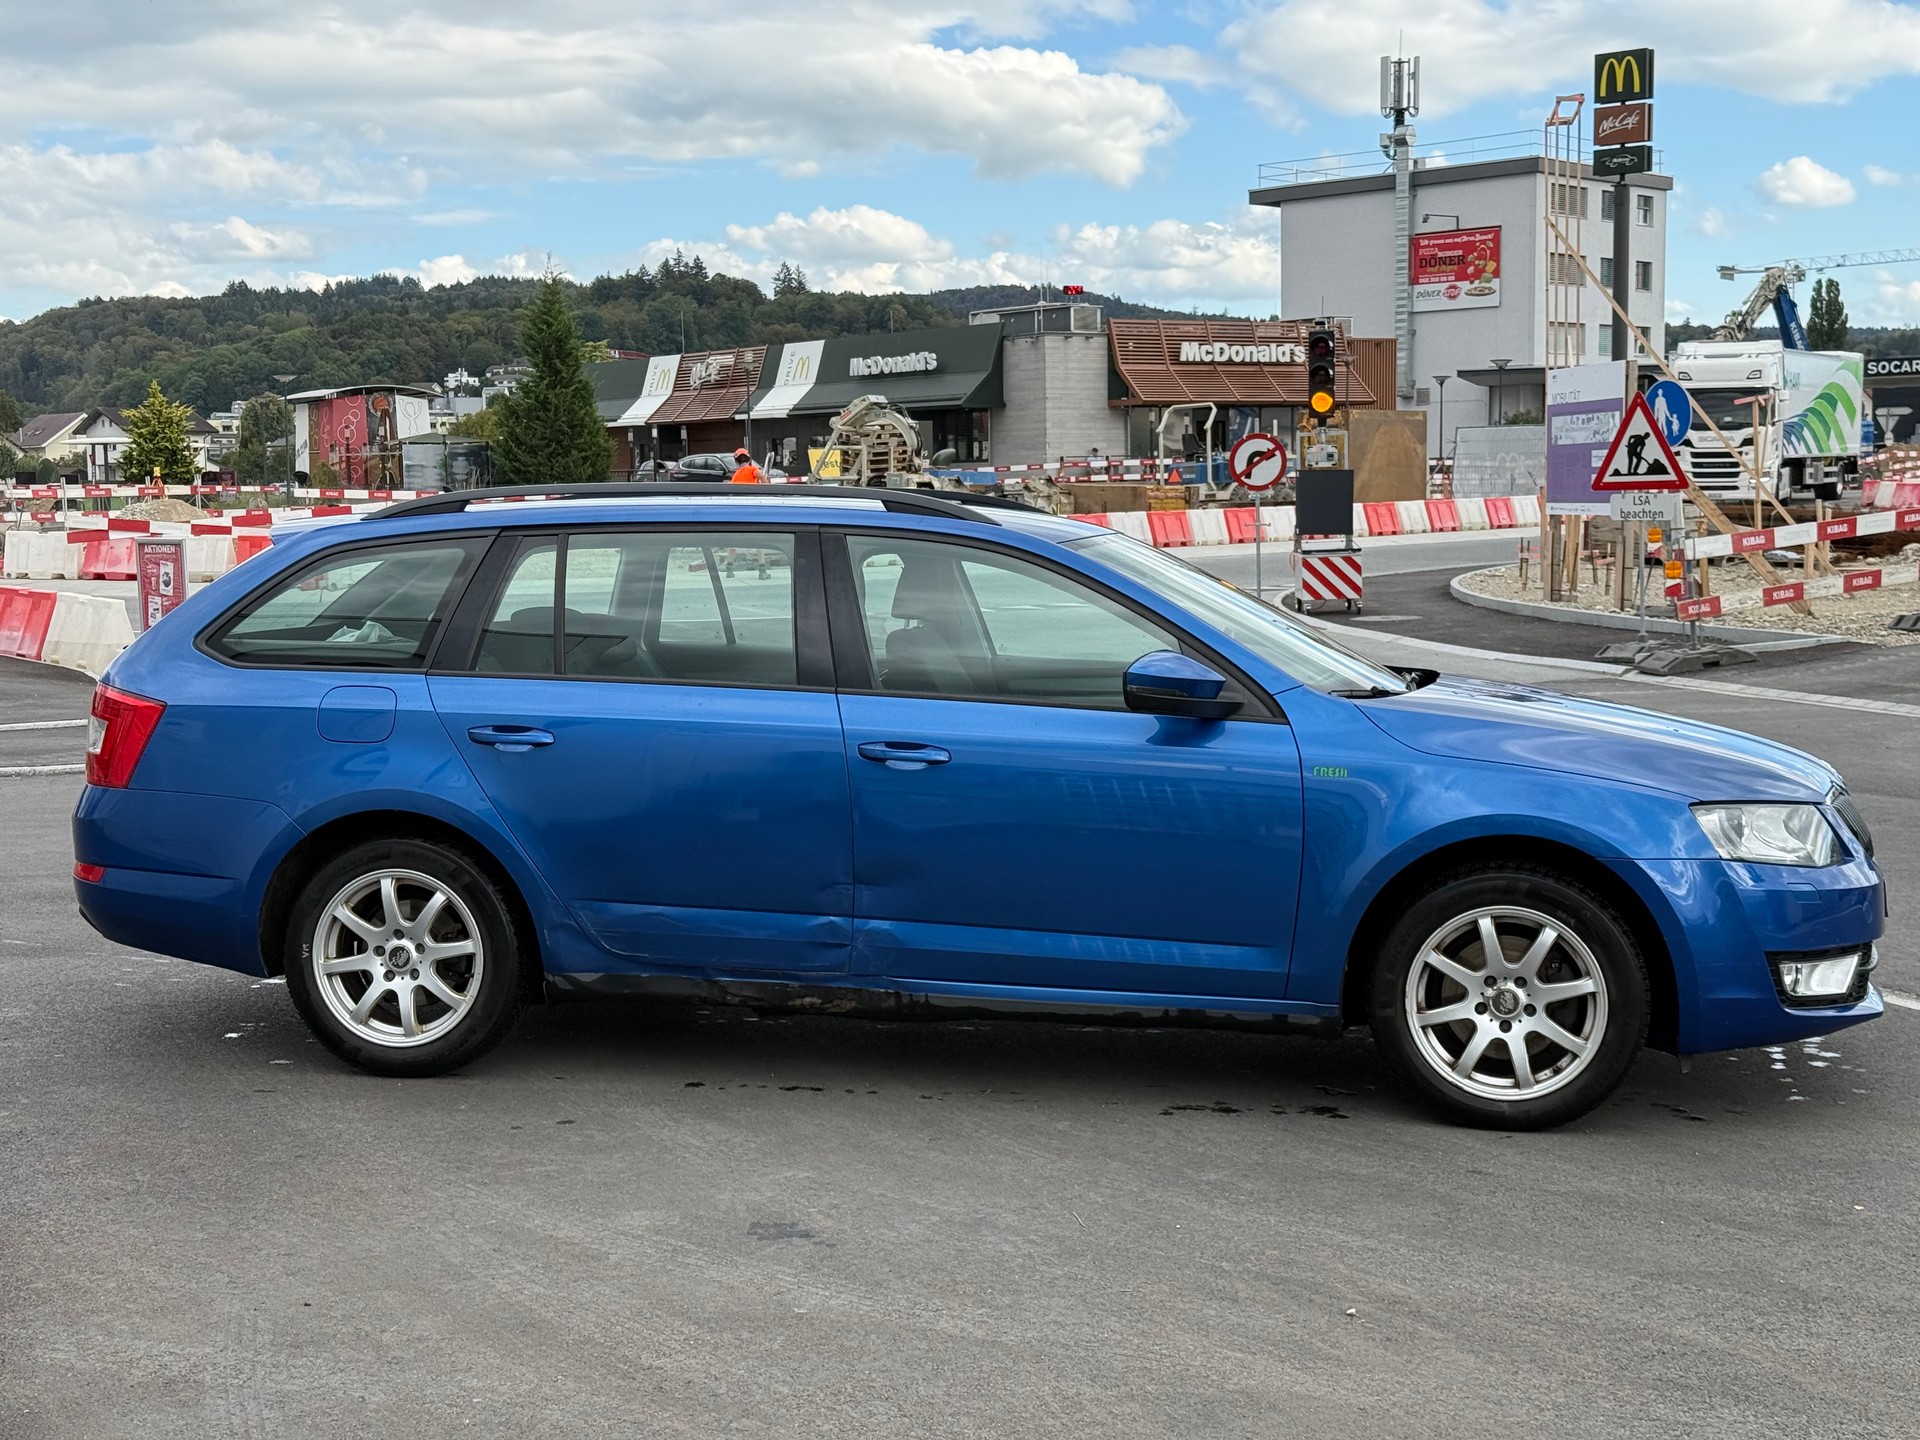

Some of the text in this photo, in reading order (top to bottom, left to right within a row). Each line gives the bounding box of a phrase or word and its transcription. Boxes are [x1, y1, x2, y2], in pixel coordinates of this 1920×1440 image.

[1419, 254, 1465, 268] DÖNER
[1179, 341, 1306, 363] McDonald's
[784, 350, 797, 386] DRIVE
[849, 351, 938, 377] McDonald's
[1866, 360, 1920, 375] SOCAR
[647, 362, 660, 397] DRIVE
[1633, 496, 1651, 506] LSA
[1620, 508, 1664, 519] beachten
[1742, 534, 1766, 546] KIBAG
[1826, 523, 1848, 535] KIBAG
[144, 544, 176, 554] AKTIONEN
[1772, 588, 1795, 600] KIBAG
[1852, 575, 1873, 586] KIBAG
